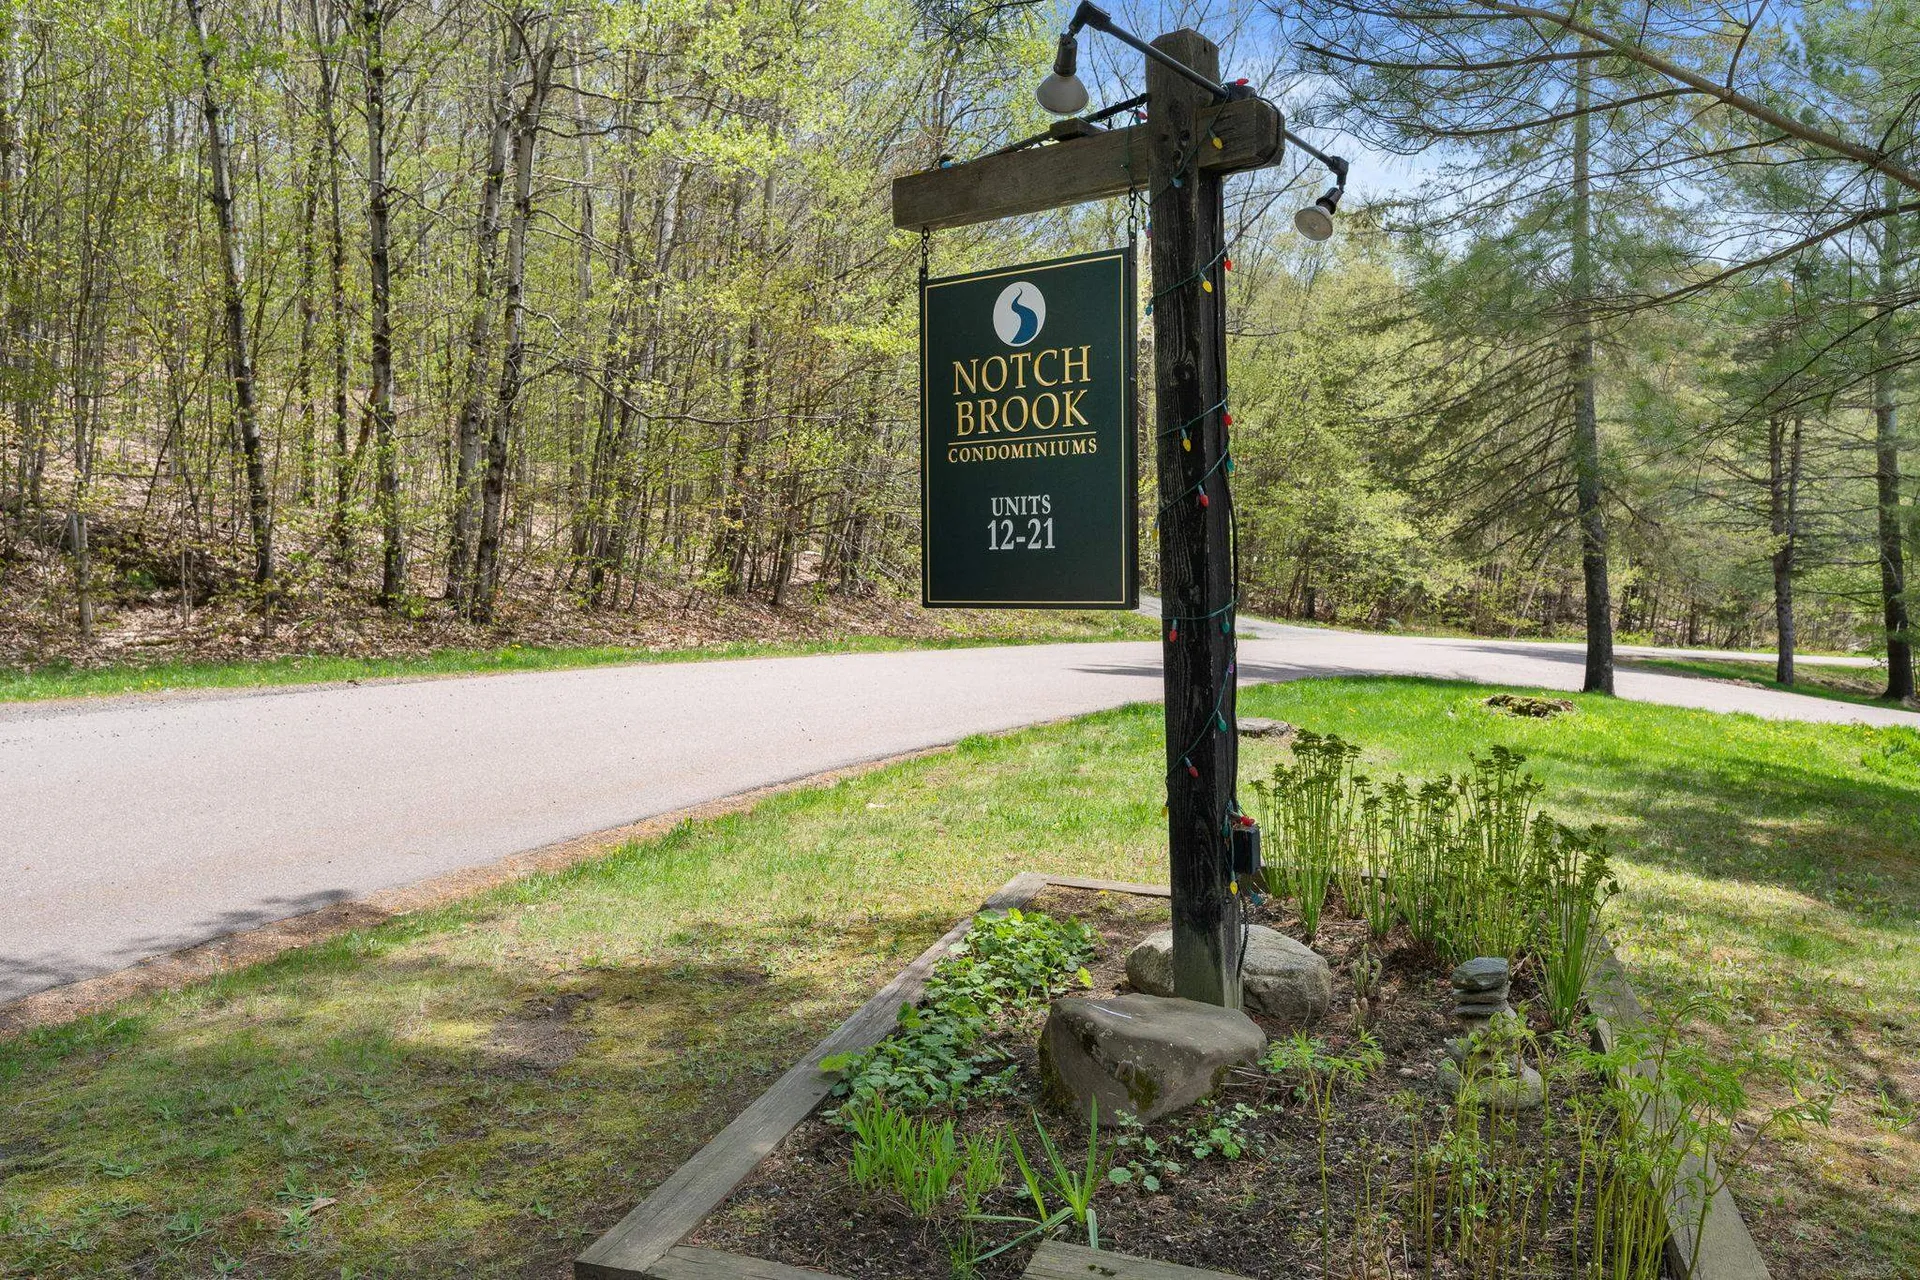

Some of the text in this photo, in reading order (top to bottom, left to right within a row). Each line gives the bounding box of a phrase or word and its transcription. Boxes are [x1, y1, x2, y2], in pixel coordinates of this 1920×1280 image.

[952, 345, 1092, 396] NOTCH
[955, 389, 1089, 437] BROOK
[948, 438, 1098, 463] CONDOMINIUMS
[990, 494, 1051, 517] UNITS
[987, 517, 1056, 551] 12-21
